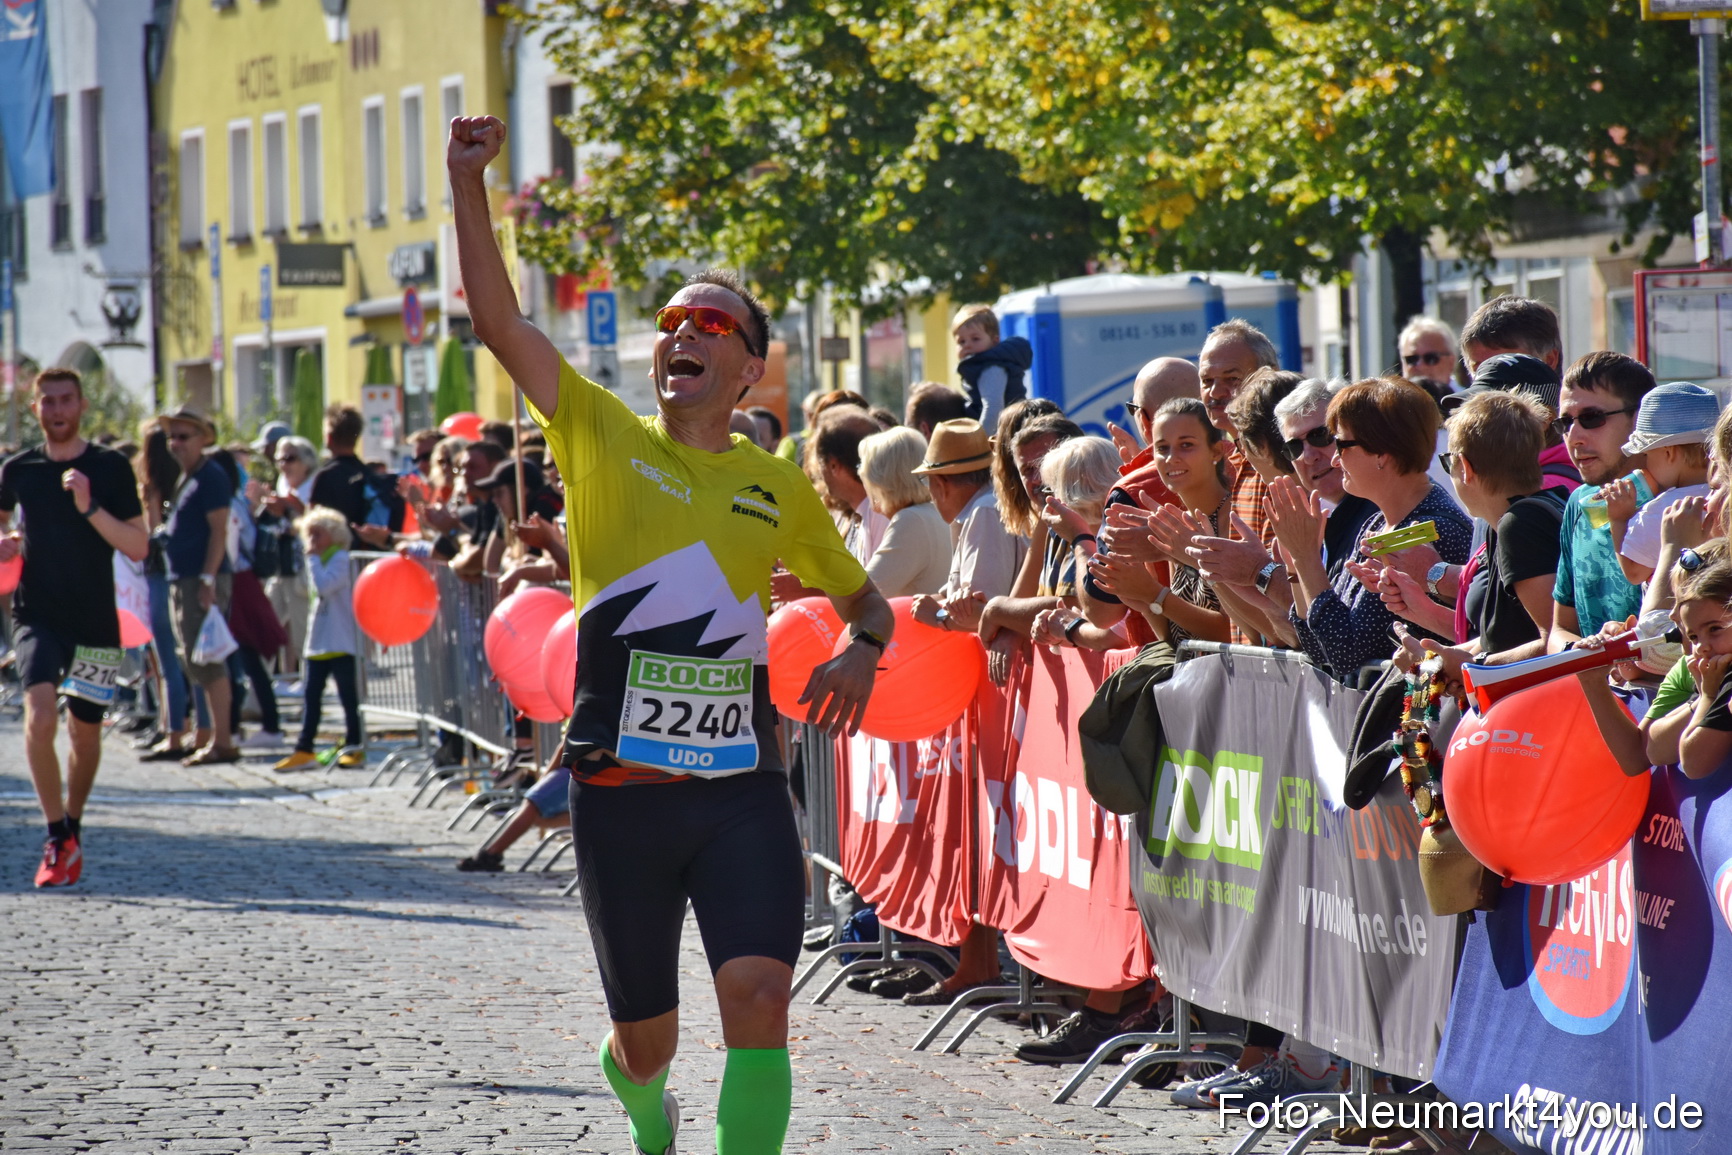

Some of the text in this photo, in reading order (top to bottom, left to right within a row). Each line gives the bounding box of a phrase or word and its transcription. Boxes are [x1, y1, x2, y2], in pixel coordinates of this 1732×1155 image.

[592, 297, 611, 341] P
[659, 483, 692, 504] MARX
[731, 503, 779, 528] Runners
[72, 662, 117, 686] 2210
[640, 659, 744, 690] BOCK
[638, 697, 741, 739] 2240
[668, 748, 714, 767] UDO
[1490, 746, 1541, 759] energie
[1151, 759, 1262, 856] BOCK
[1643, 813, 1685, 852] STORE
[1143, 861, 1190, 904] inspired
[1192, 868, 1205, 909] by
[1543, 943, 1591, 981] SPORTS
